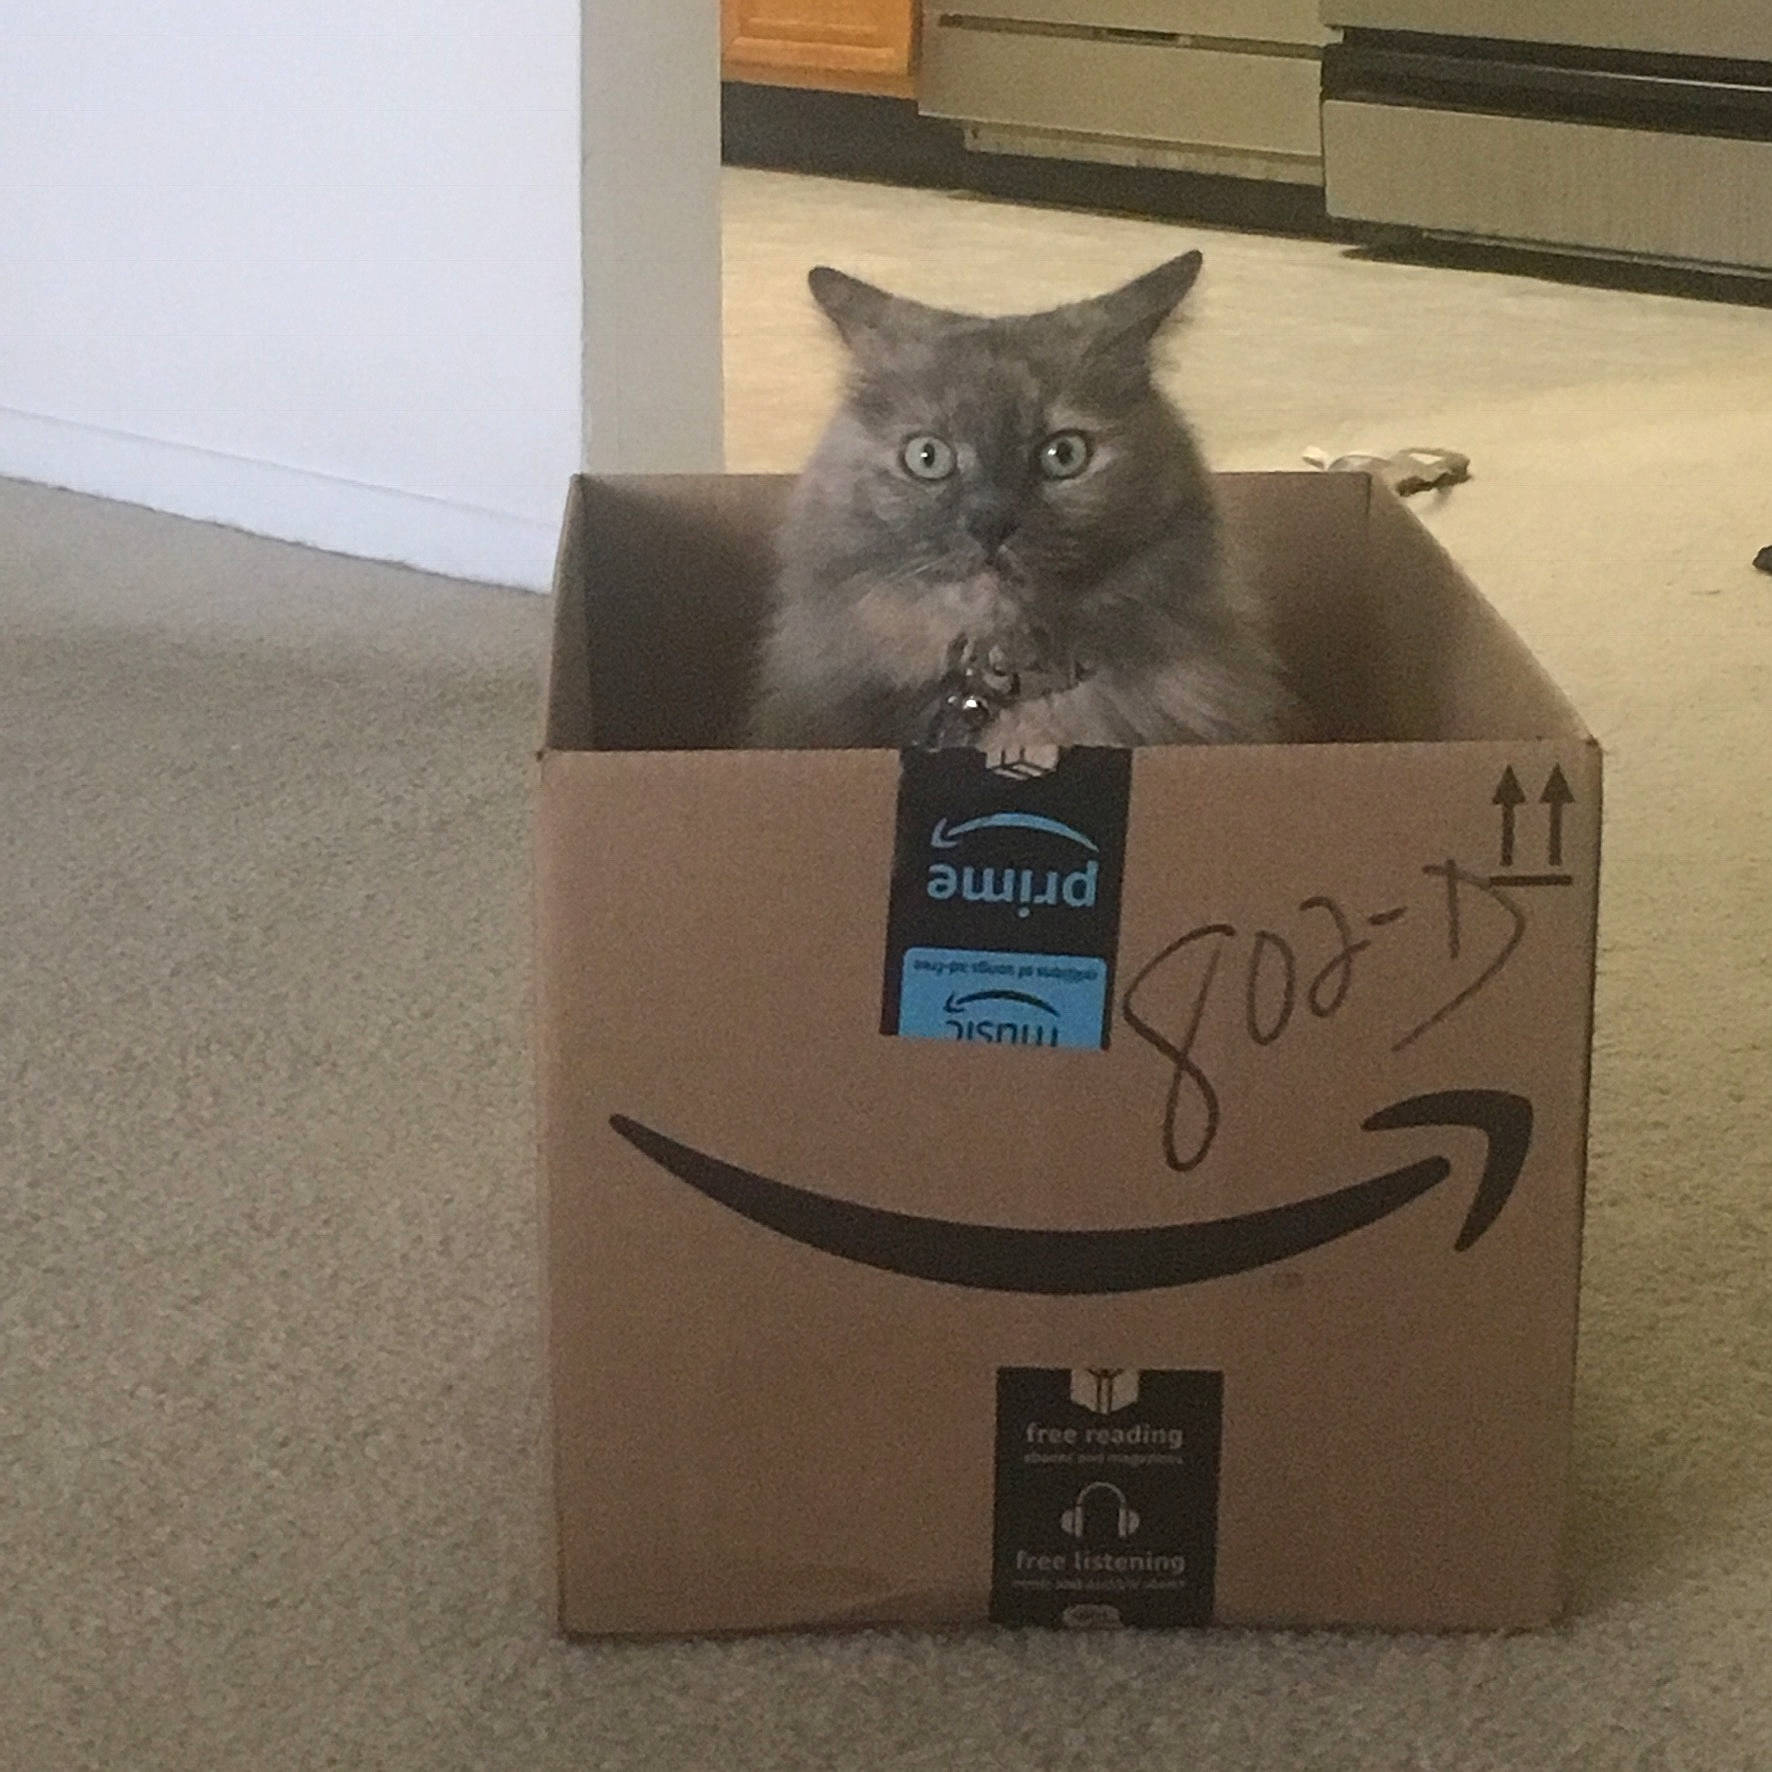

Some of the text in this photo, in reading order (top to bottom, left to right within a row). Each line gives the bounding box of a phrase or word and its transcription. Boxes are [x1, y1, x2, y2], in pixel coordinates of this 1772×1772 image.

[927, 860, 1098, 918] prime
[1026, 1421, 1183, 1449] free reading
[1016, 1549, 1186, 1575] free listening
